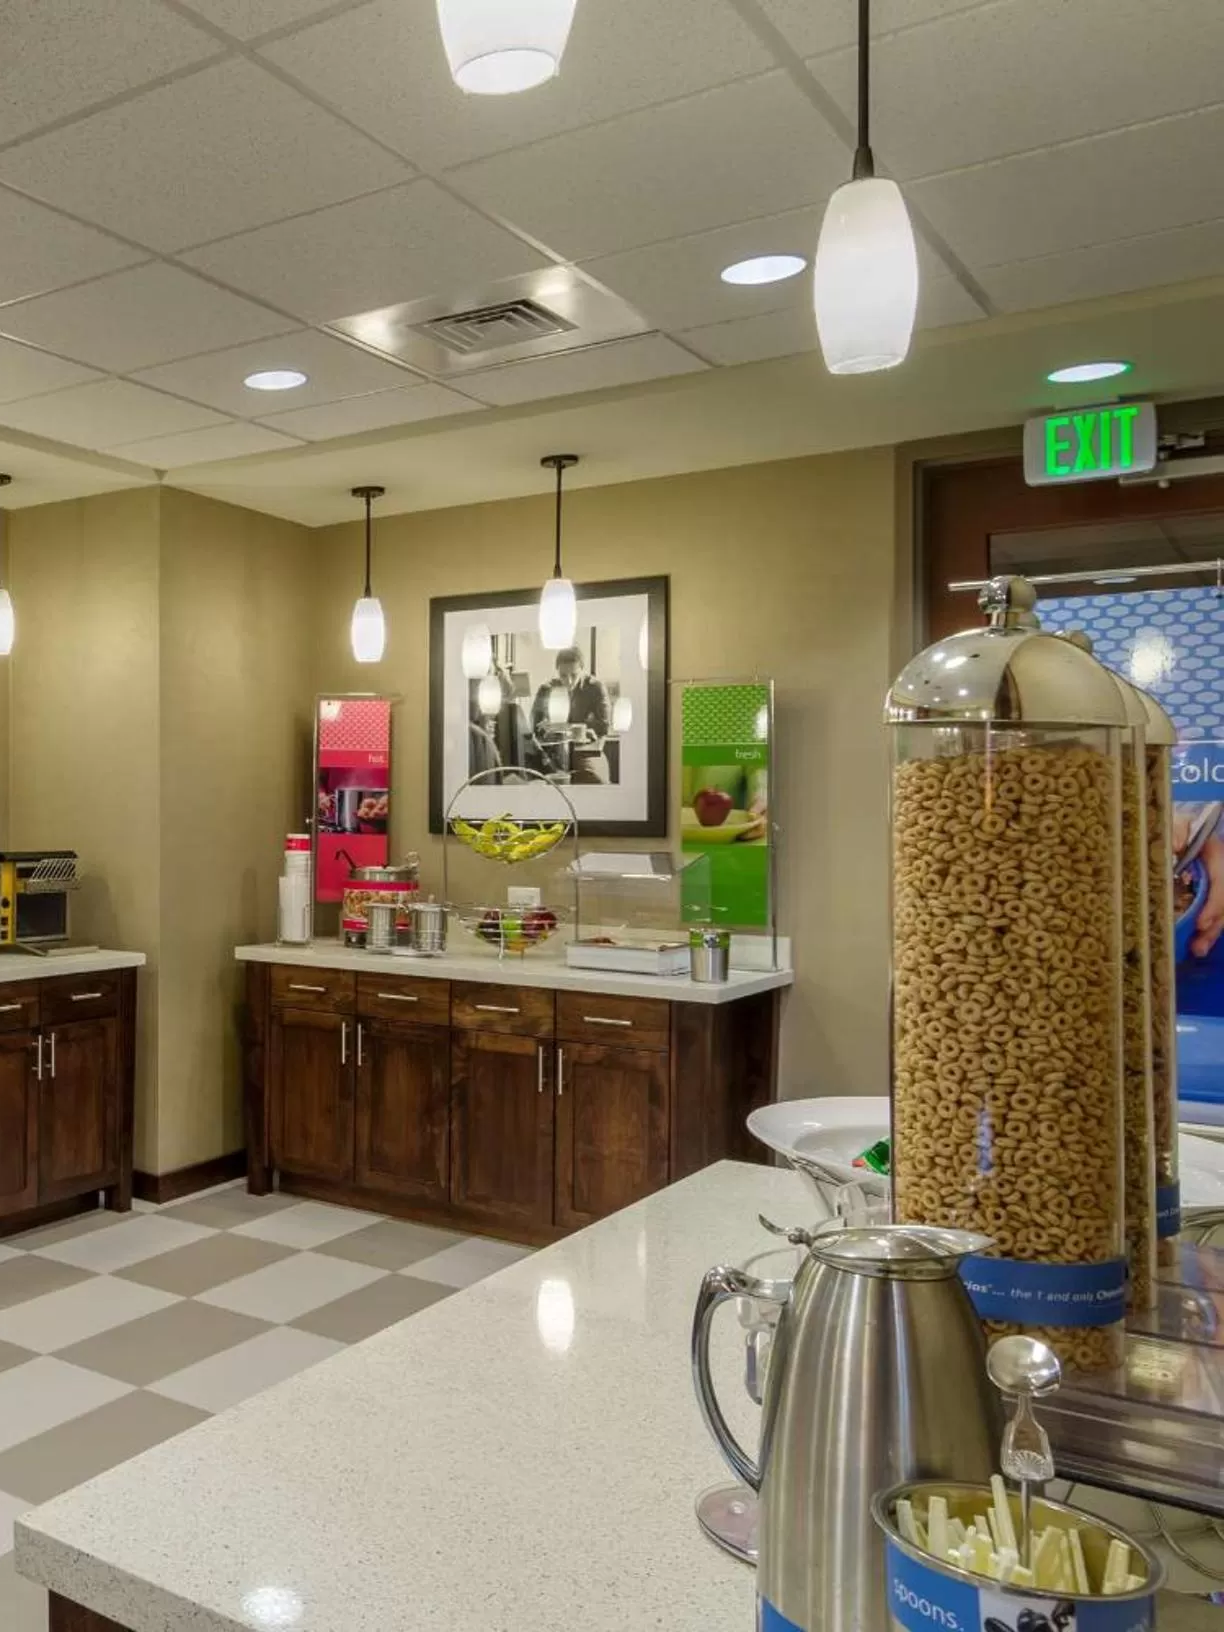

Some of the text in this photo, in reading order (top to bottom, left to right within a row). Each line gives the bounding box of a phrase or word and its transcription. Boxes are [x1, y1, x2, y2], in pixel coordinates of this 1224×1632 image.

[1045, 405, 1139, 475] EXIT
[1010, 1288, 1033, 1299] the
[1047, 1291, 1070, 1302] and
